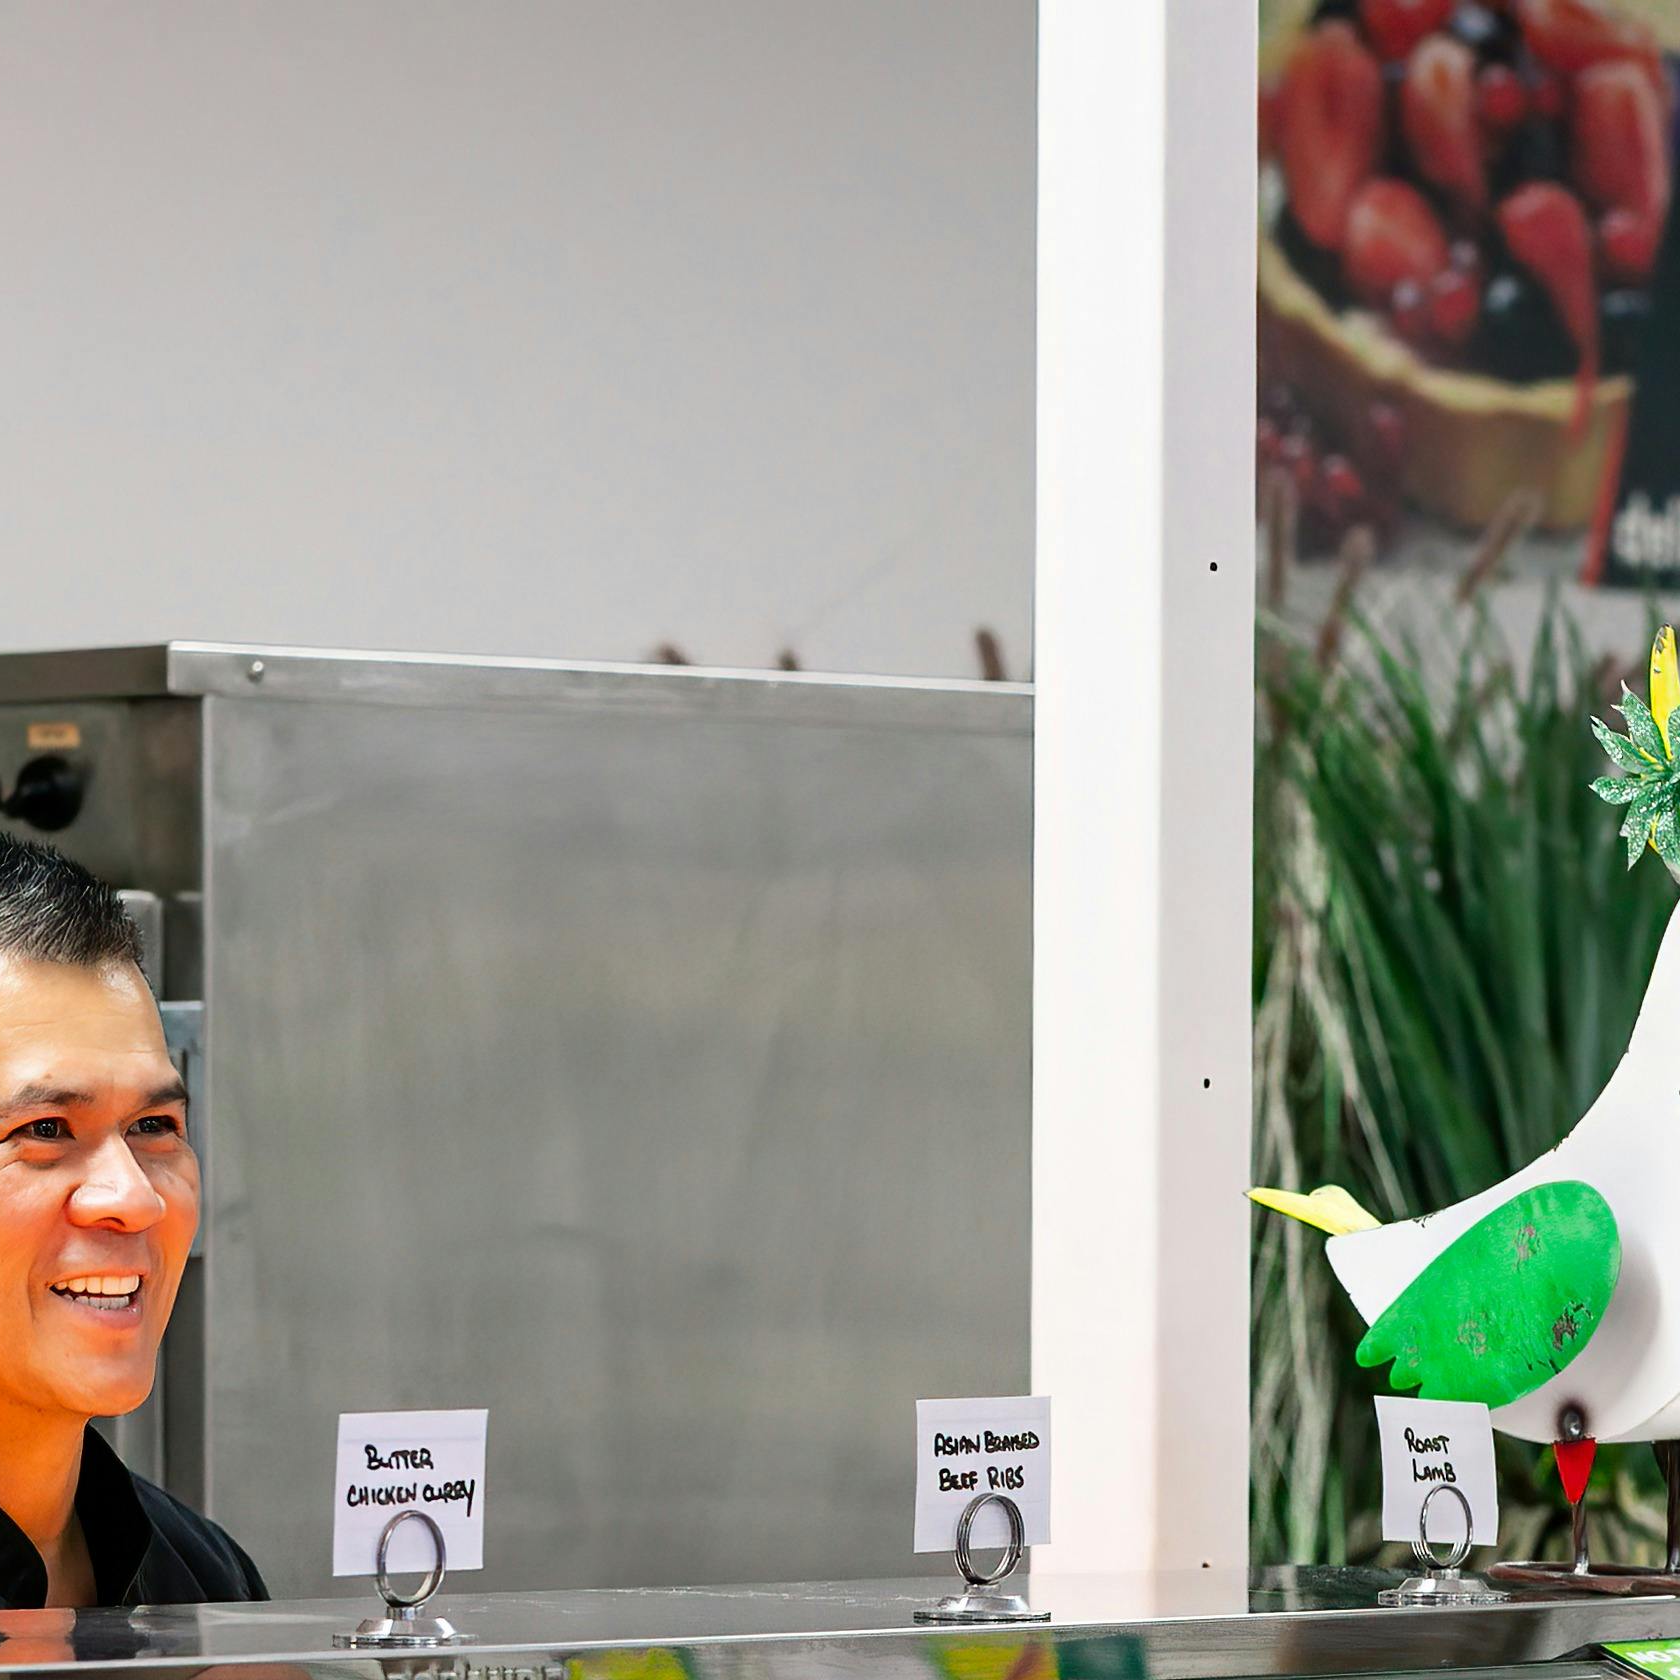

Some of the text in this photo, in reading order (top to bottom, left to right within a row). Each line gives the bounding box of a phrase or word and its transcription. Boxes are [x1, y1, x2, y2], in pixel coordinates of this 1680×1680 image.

[934, 1432, 980, 1457] ASIAN
[1404, 1427, 1450, 1454] ROAST
[364, 1444, 434, 1470] BUTTER
[938, 1465, 1025, 1491] BEEF RIBS
[1412, 1458, 1457, 1483] LAMB
[346, 1479, 476, 1517] CHICKEN CURRY
